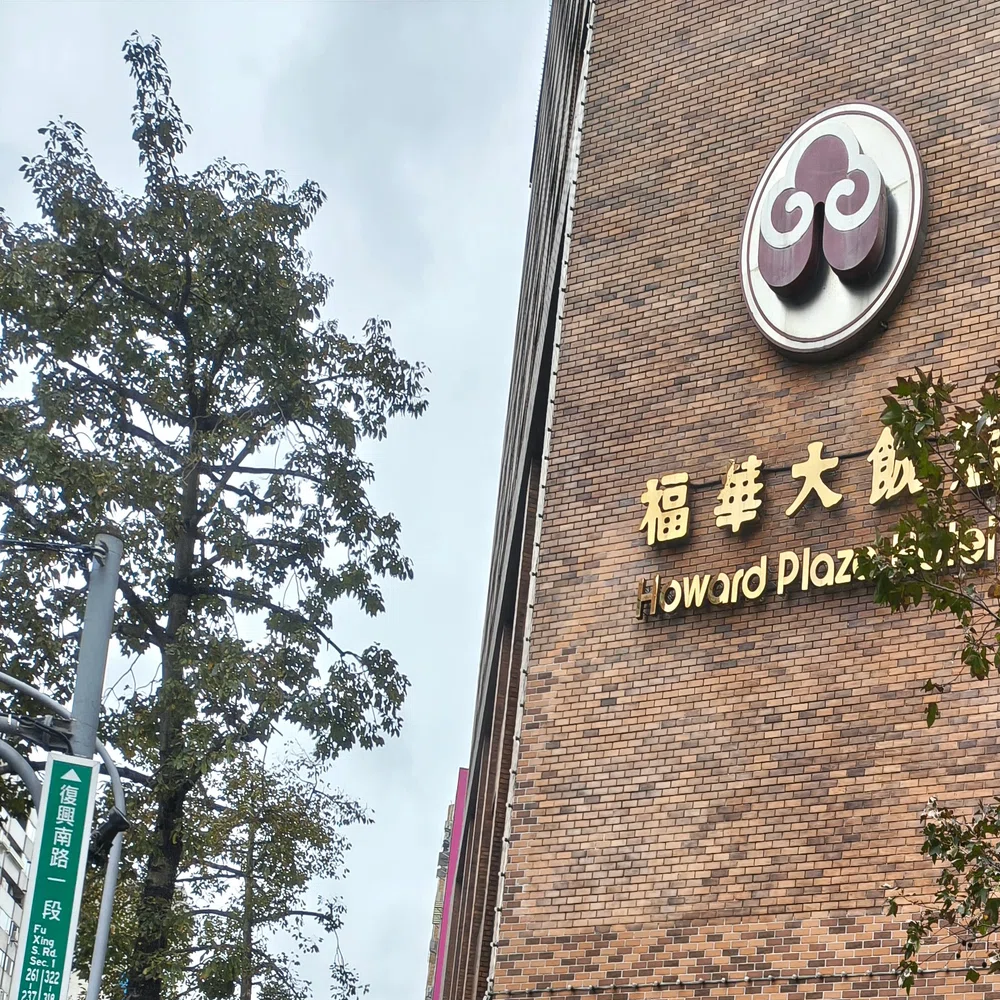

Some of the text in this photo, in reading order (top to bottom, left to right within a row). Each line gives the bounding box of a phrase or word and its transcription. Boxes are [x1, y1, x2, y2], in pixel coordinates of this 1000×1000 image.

[636, 555, 767, 620] Howard
[42, 784, 79, 921] 復興南路一段
[33, 924, 47, 934] Fu
[32, 935, 55, 948] Xing
[29, 956, 56, 968] Sec. 1
[25, 967, 39, 982] 261
[44, 970, 60, 985] 322
